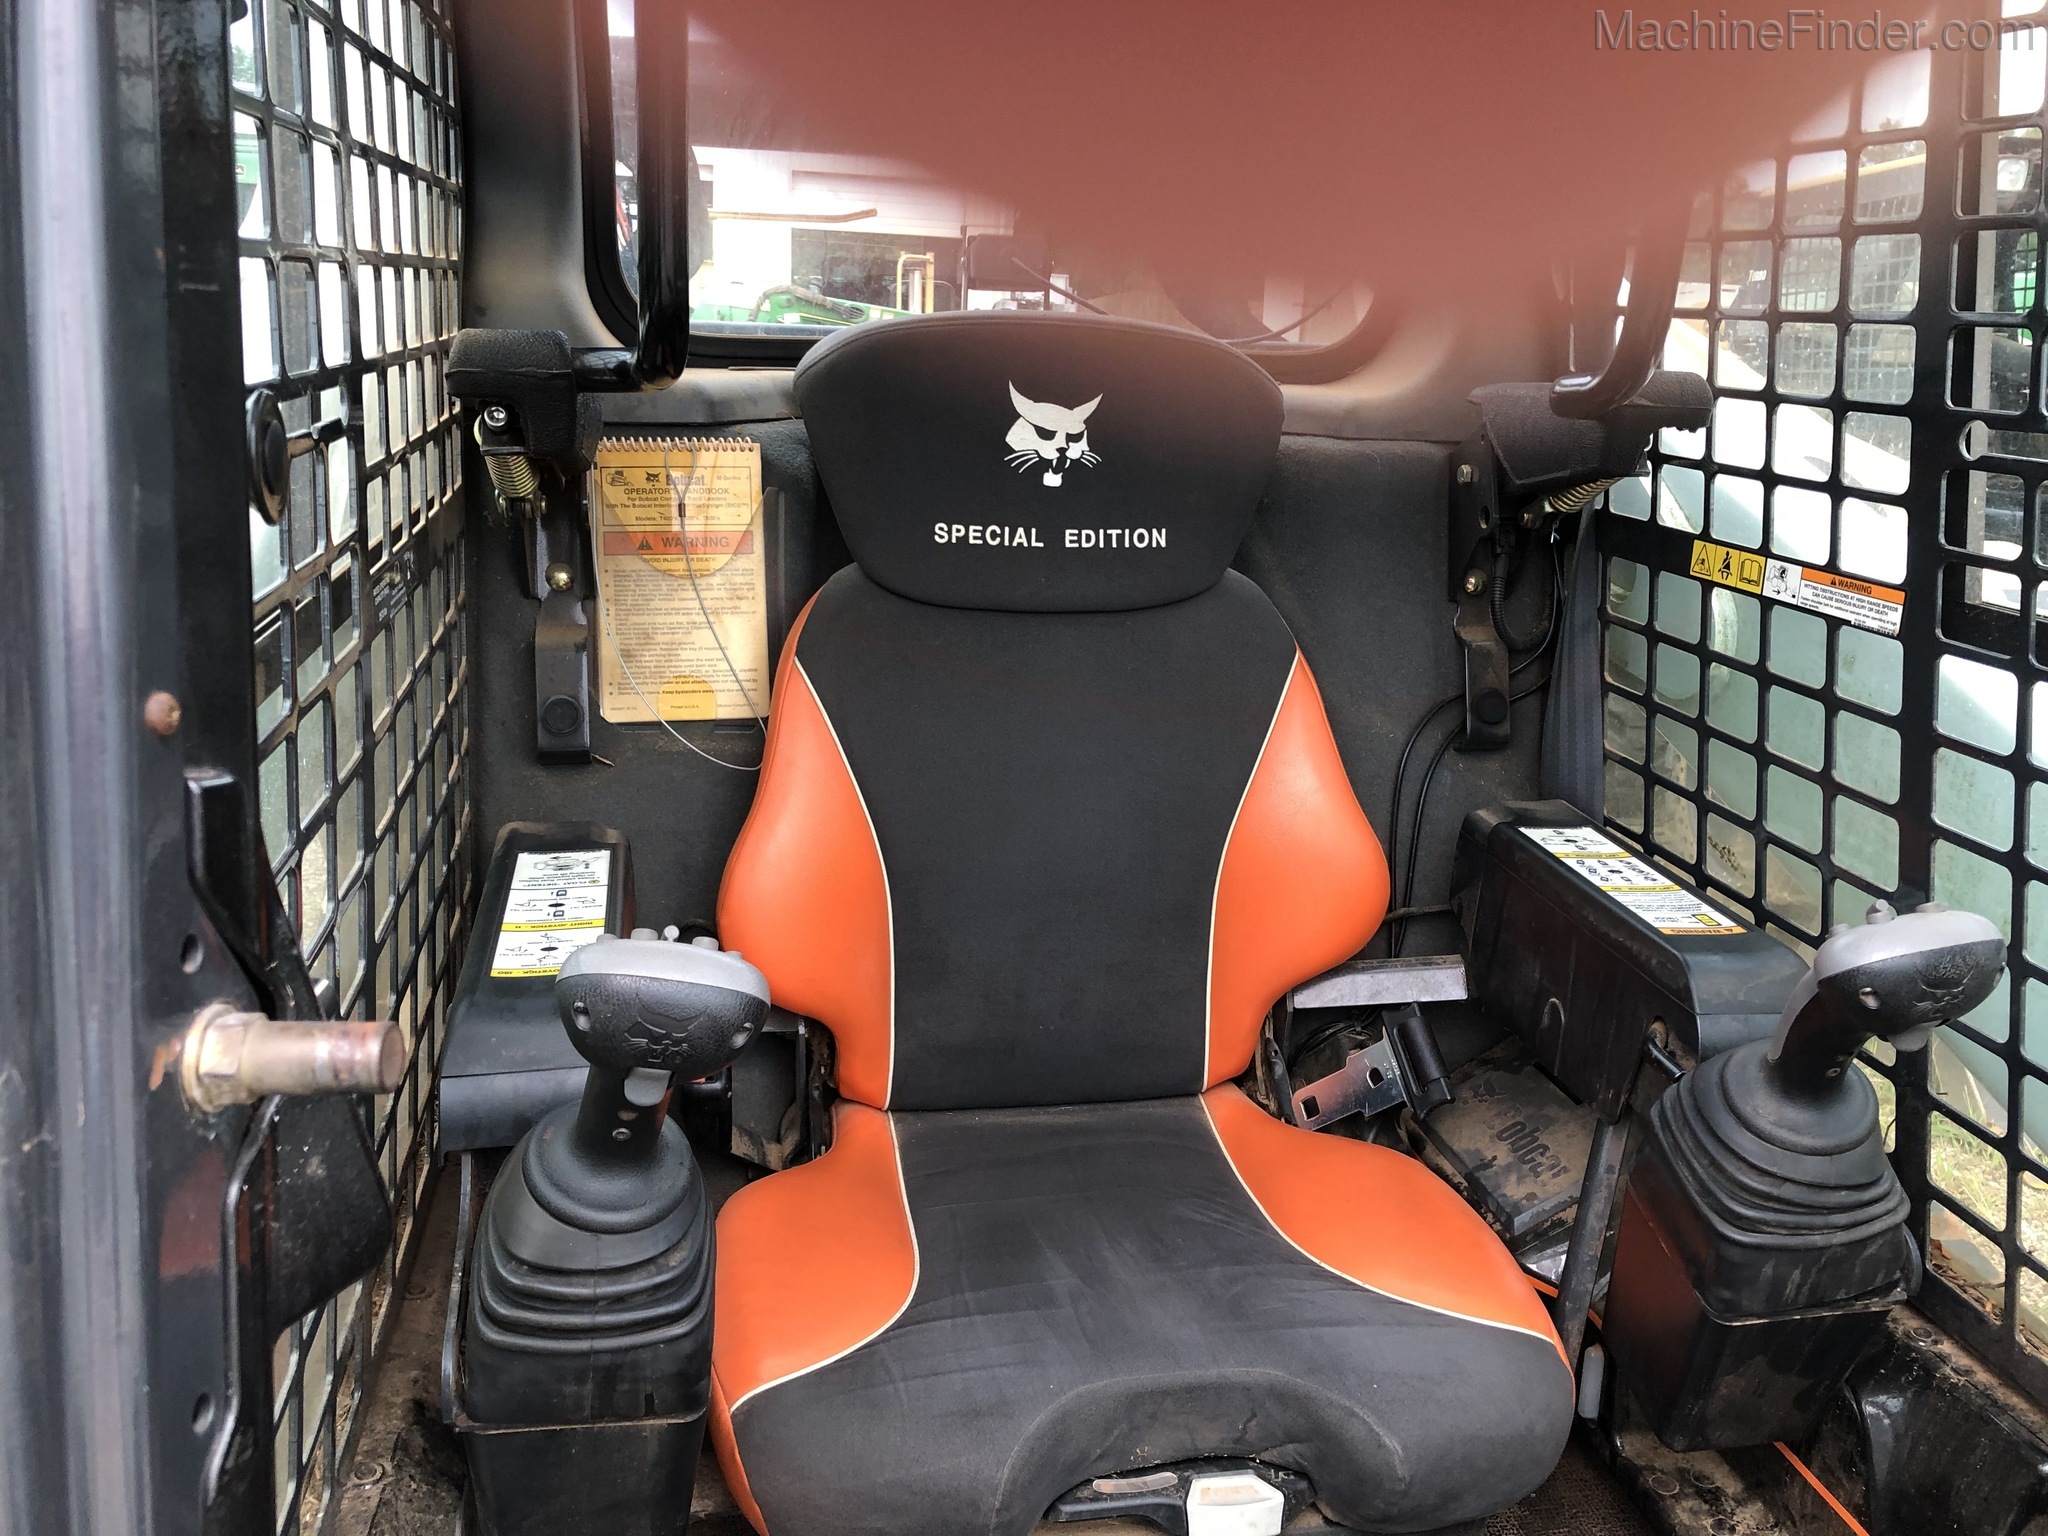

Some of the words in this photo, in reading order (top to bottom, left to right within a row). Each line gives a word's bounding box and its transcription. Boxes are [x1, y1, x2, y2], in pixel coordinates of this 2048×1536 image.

[660, 536, 730, 548] WARNING
[934, 522, 1044, 548] SPECIAL
[1064, 528, 1167, 549] EDITION
[1838, 579, 1872, 594] WARNING
[1820, 588, 1850, 600] OBSTRUCTIONS
[1867, 600, 1881, 608] RANGE
[1882, 604, 1898, 613] SPEEDS
[1835, 598, 1852, 606] SERIOUS
